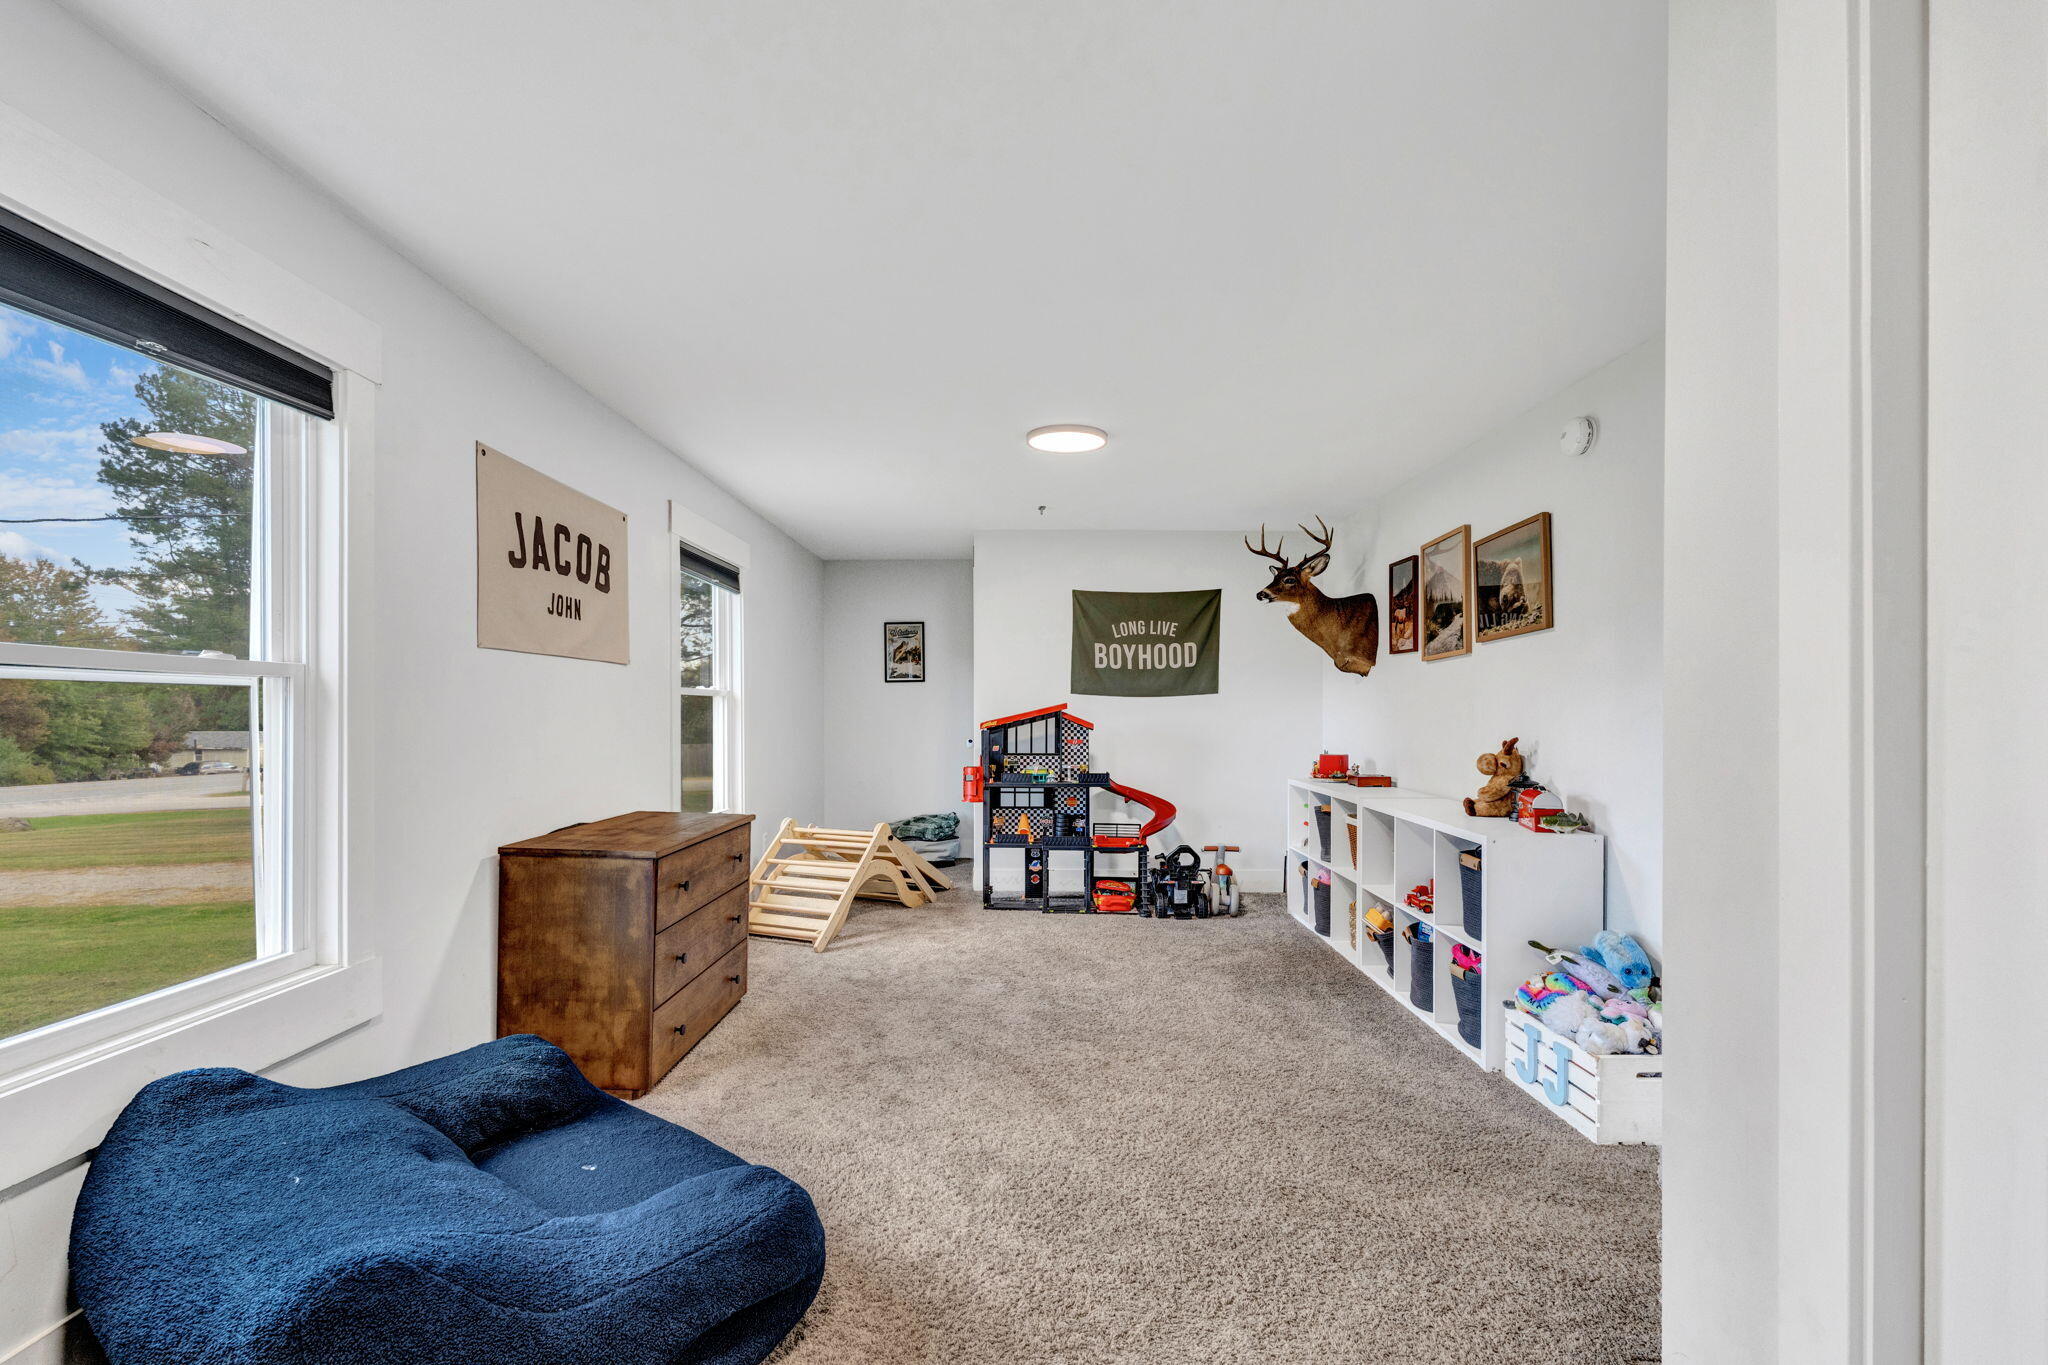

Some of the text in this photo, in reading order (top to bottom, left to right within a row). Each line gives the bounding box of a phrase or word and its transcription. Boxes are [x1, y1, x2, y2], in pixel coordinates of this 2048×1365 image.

[508, 511, 611, 594] JACOB
[547, 592, 582, 621] JOHN
[1111, 620, 1179, 638] LONG LIVE
[1094, 642, 1198, 670] BOYHOOD
